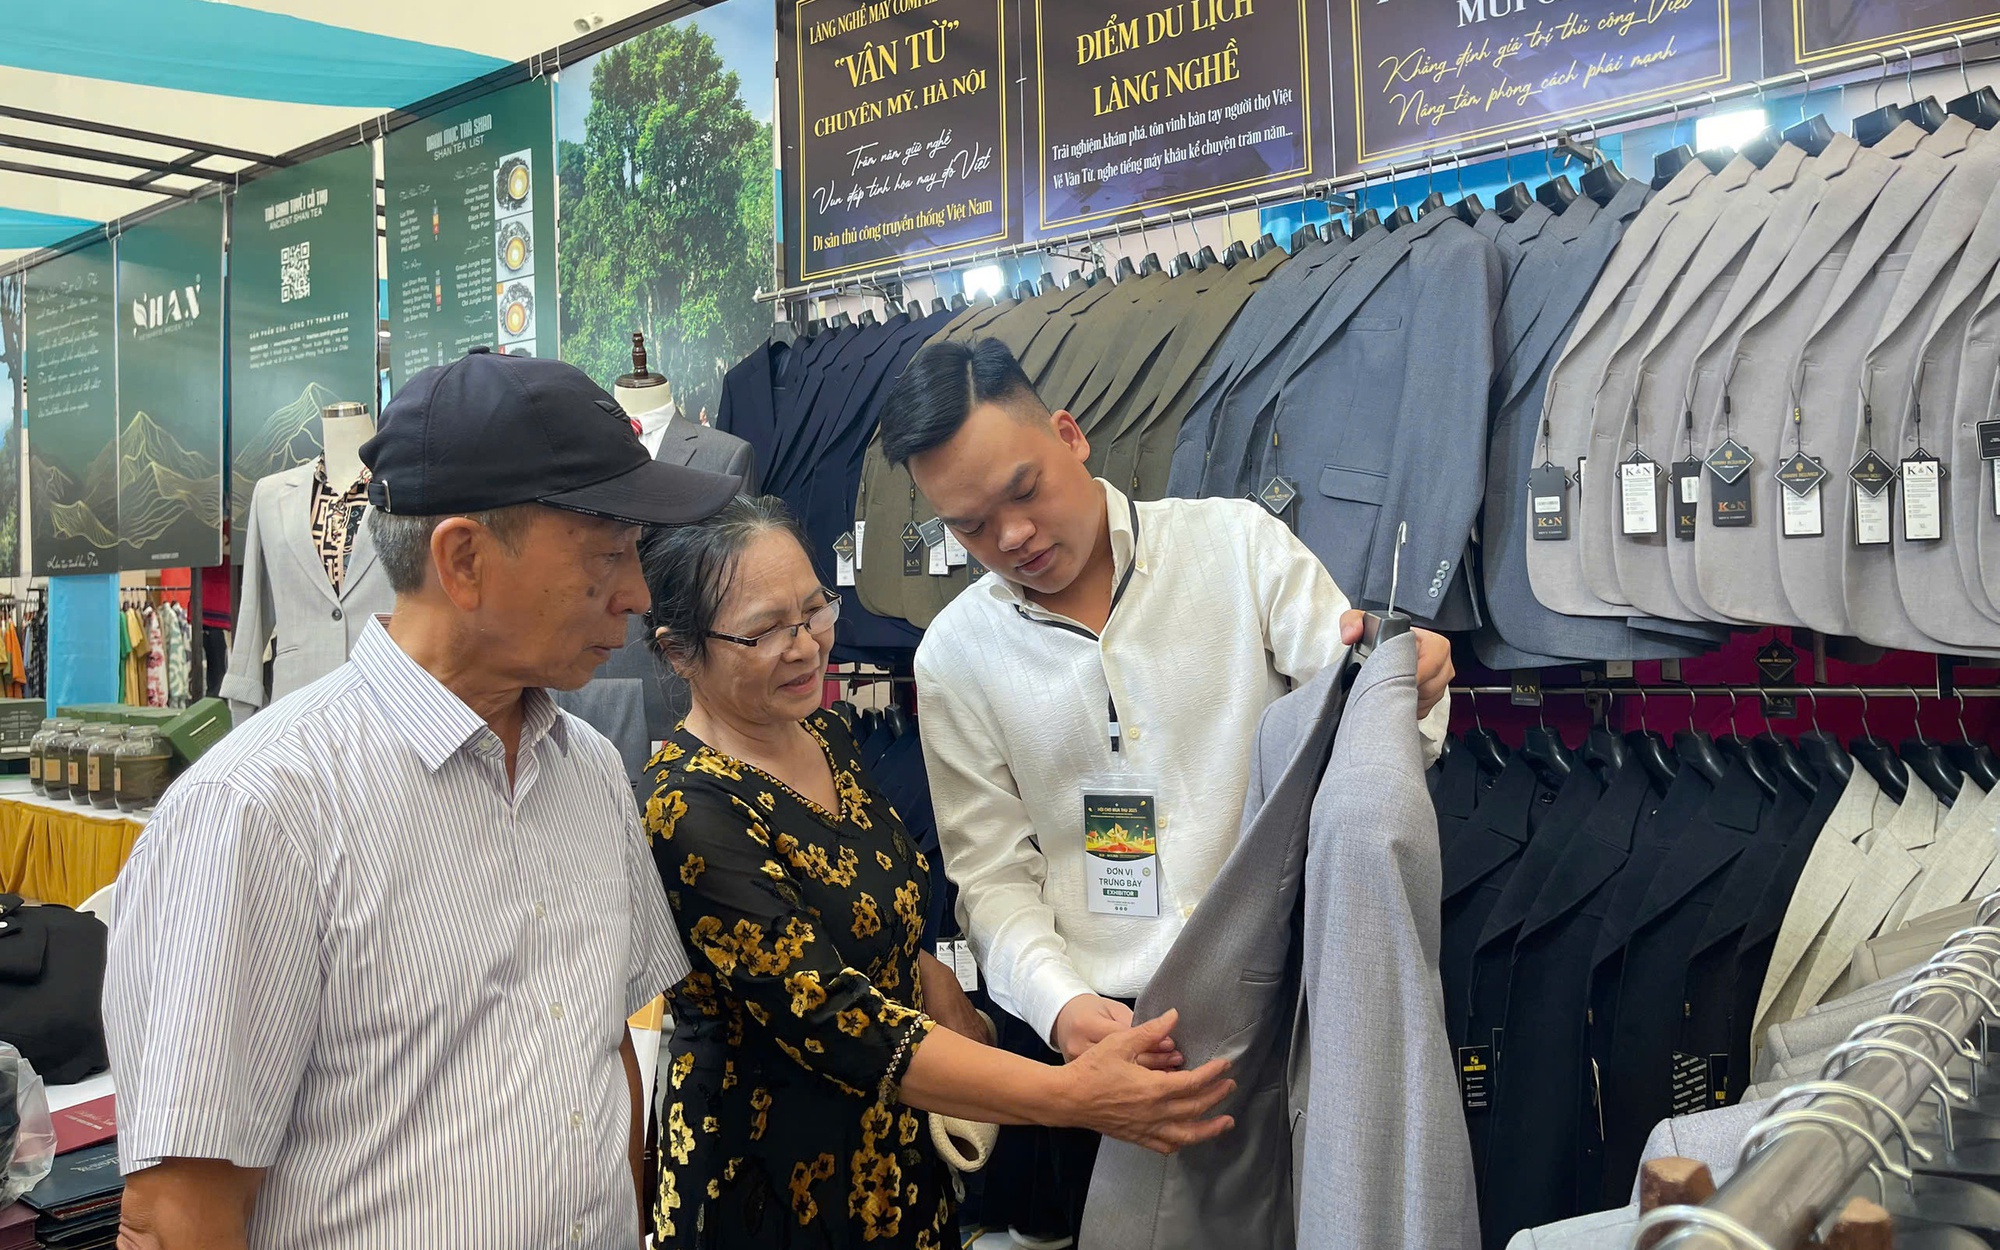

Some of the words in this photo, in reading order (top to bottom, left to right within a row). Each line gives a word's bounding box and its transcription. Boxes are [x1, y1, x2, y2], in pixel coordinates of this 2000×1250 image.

[810, 20, 836, 45] LÀNG
[838, 2, 867, 36] NGHỀ
[868, 0, 891, 24] MAY
[1076, 13, 1140, 65] ĐIỂM
[1146, 4, 1184, 45] DU
[1191, 0, 1255, 31] LỊCH
[1093, 70, 1160, 117] LÀNG
[1164, 37, 1240, 97] NGHỀ
[1378, 47, 1457, 93] Khẳng
[1456, 38, 1491, 78] định
[1493, 37, 1523, 68] giá
[1524, 20, 1553, 48] trị
[1555, 12, 1590, 40] thủ
[1597, 11, 1647, 36] công
[814, 101, 882, 138] CHUYÊN
[923, 79, 949, 106] HÀ
[952, 68, 987, 97] NỘI
[1389, 89, 1456, 126] Nâng
[1449, 84, 1482, 110] tầm
[1486, 77, 1542, 112] phong
[1541, 60, 1579, 89] cách
[1582, 52, 1624, 89] phái
[1630, 35, 1677, 68] mạnh
[433, 146, 452, 161] SHAN
[453, 141, 467, 153] TEA
[469, 134, 485, 148] LIST
[460, 118, 473, 140] TRÀ
[902, 142, 922, 166] giữ
[926, 129, 952, 158] nghề
[1052, 144, 1069, 161] Trải
[1149, 121, 1164, 137] tôn
[1165, 114, 1186, 132] vinh
[1207, 107, 1223, 125] tay
[1224, 98, 1252, 120] người
[1253, 93, 1271, 111] thợ
[1272, 88, 1293, 106] Việt
[812, 180, 843, 215] Vun
[865, 176, 891, 199] tinh
[894, 173, 913, 192] hoa
[916, 173, 943, 192] may
[953, 141, 992, 180] Việt
[1064, 171, 1080, 187] Vân
[1097, 162, 1119, 182] nghe
[1120, 157, 1143, 175] tiếng
[1143, 151, 1163, 170] máy
[1164, 148, 1187, 165] khâu
[1201, 135, 1236, 156] chuyện
[1238, 131, 1262, 147] trăm
[293, 211, 310, 224] SHAN
[311, 207, 322, 218] TEA
[813, 234, 823, 252] Di
[824, 232, 839, 249] sản
[841, 227, 858, 245] thủ
[859, 224, 881, 242] công
[916, 207, 945, 230] thống
[946, 200, 966, 222] Việt
[968, 199, 993, 218] Nam
[1099, 877, 1126, 887] TRƯNG
[1126, 878, 1142, 887] BÀY
[1106, 867, 1124, 876] ĐƠN
[1125, 868, 1133, 877] VỊ
